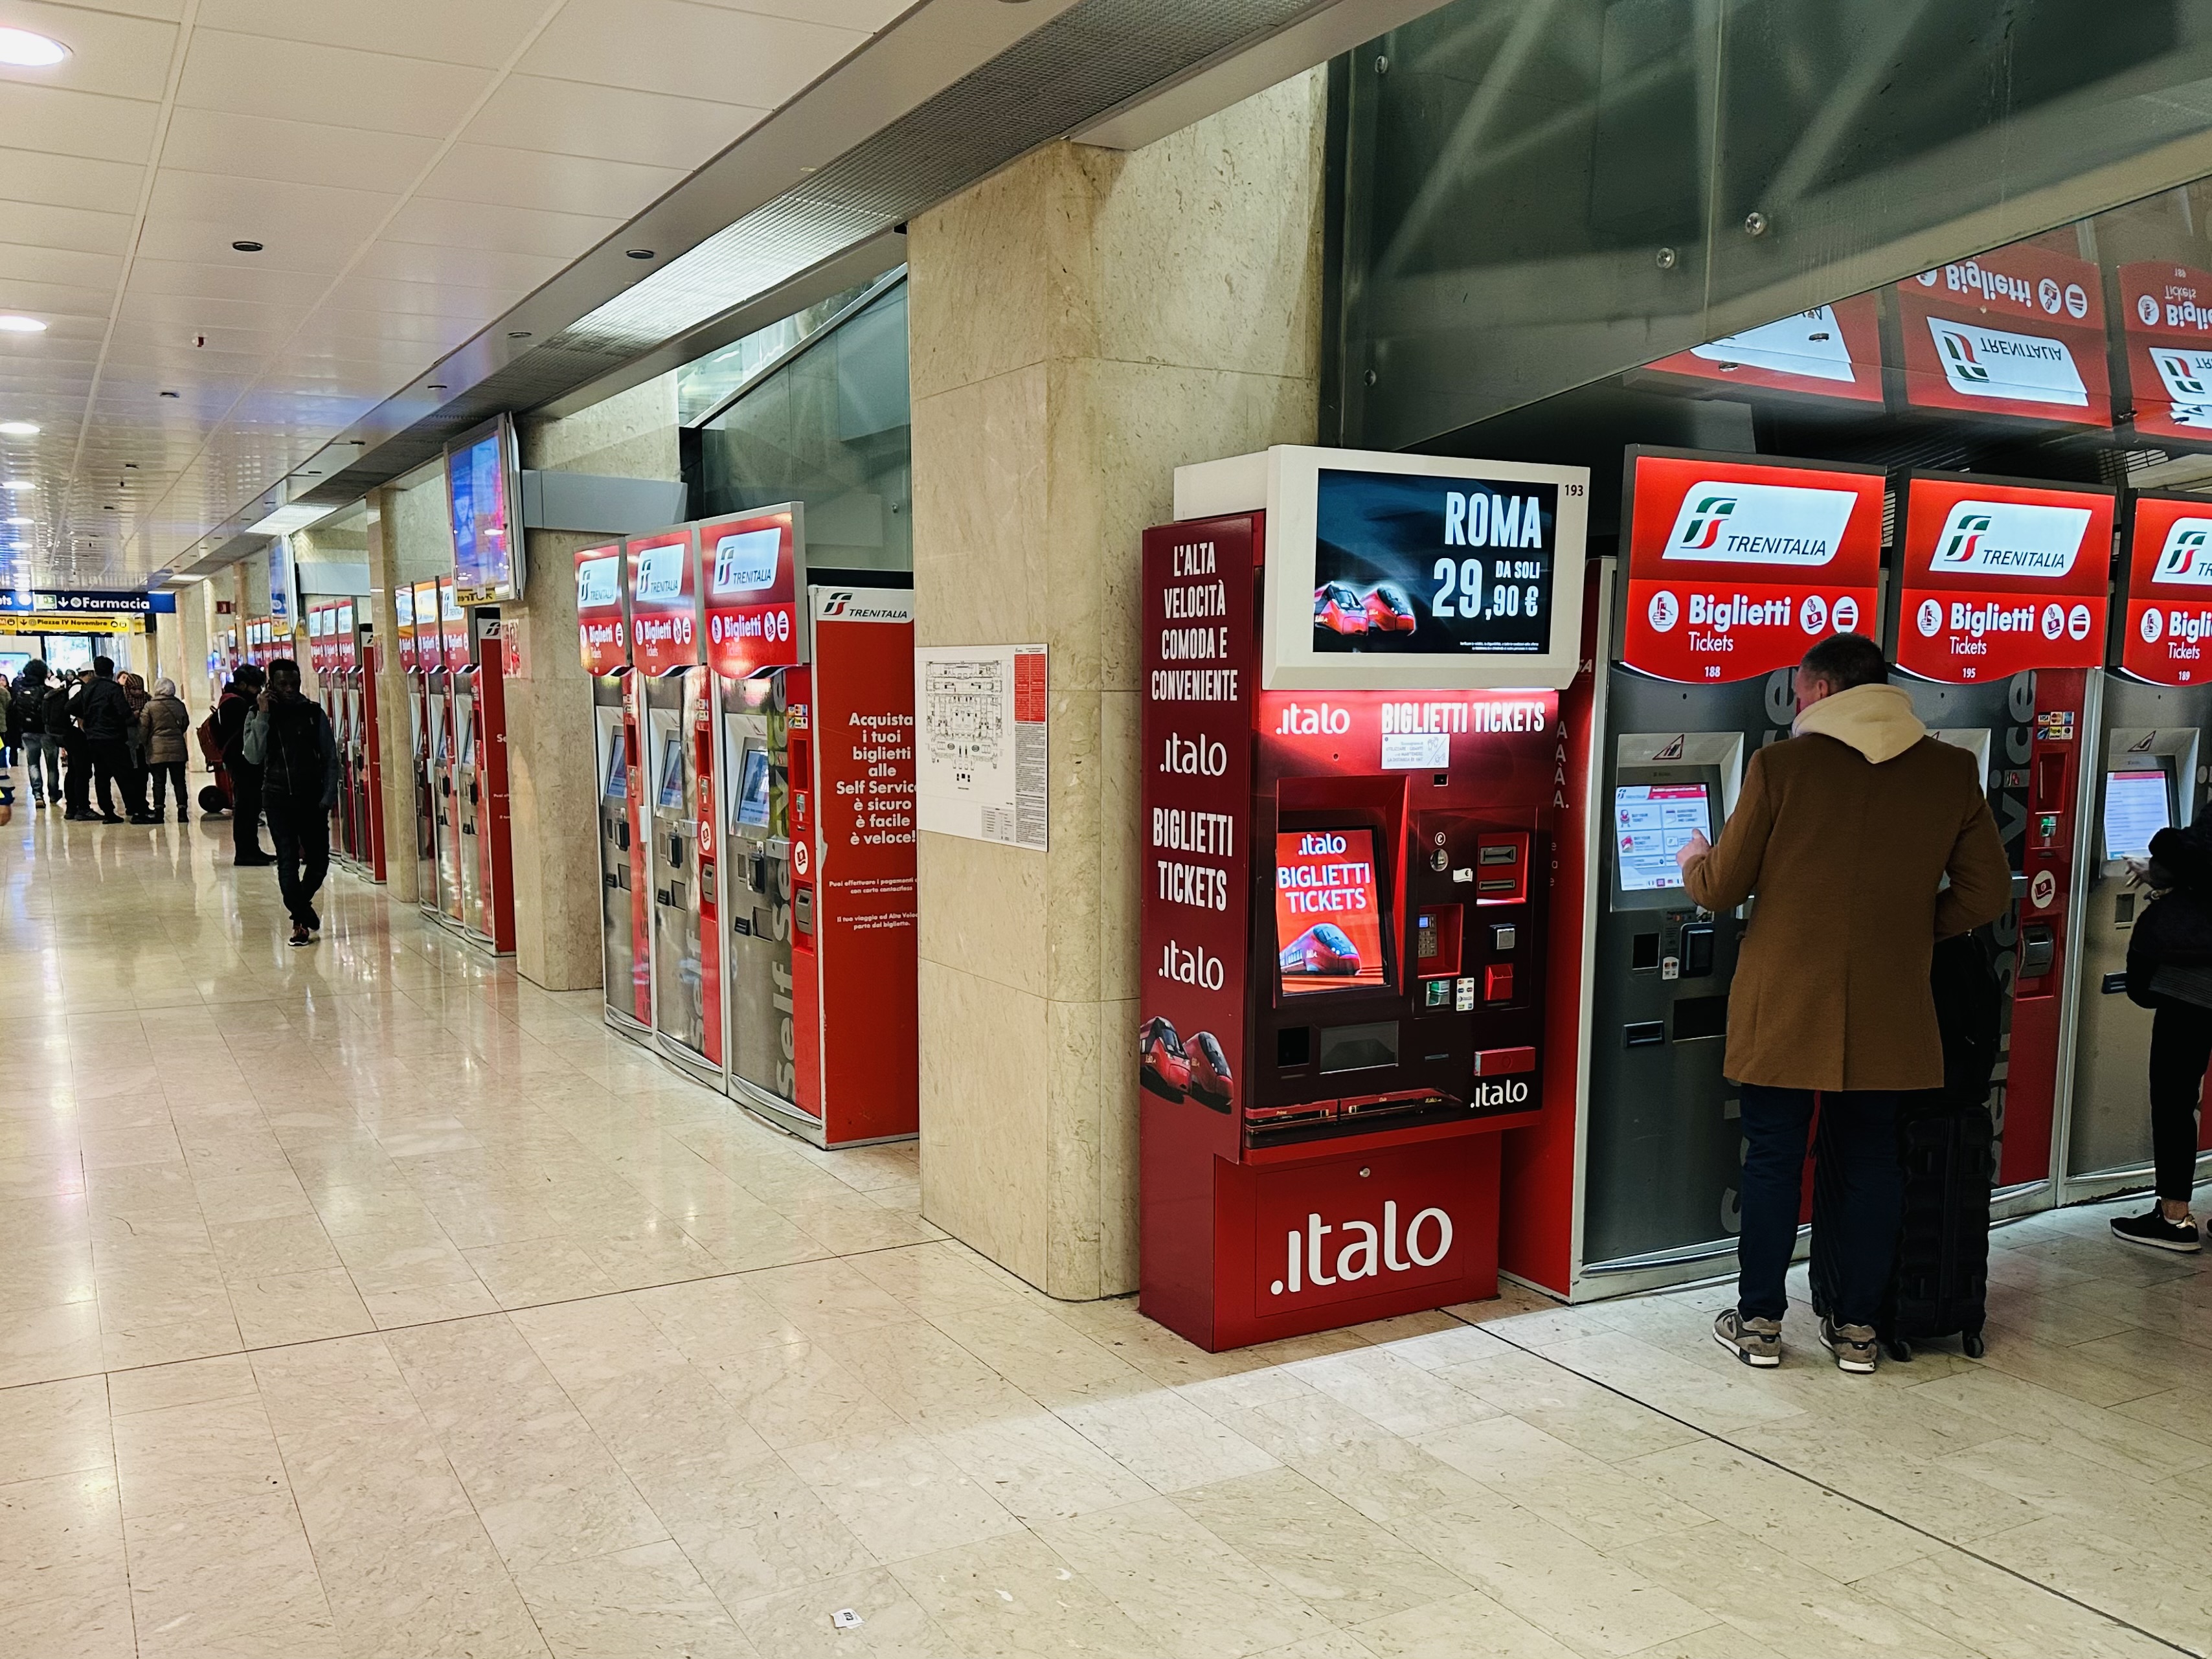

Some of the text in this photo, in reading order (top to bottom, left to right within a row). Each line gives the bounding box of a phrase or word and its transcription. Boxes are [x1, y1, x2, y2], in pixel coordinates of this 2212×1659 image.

[1564, 484, 1584, 497] 193
[1444, 491, 1542, 548] ROMA
[1727, 535, 1826, 557] TRENITALIA
[1173, 541, 1216, 577] L'ALTA
[1982, 549, 2065, 569] TRENITALIA
[733, 568, 771, 585] TRENITALIA
[1495, 561, 1540, 580] DA SOLI
[83, 597, 150, 610] Farmacia
[1164, 580, 1226, 618] VELOCITÀ
[849, 608, 908, 619] TRENITALIA
[1688, 594, 1792, 632] Biglietti
[1950, 602, 2035, 637] Biglietti
[644, 619, 672, 644] Biglietti
[723, 614, 762, 643] Biglietti
[1162, 627, 1228, 660] COMODA E
[1687, 631, 1733, 652] Tickets
[1949, 636, 1987, 655] Tickets
[2168, 642, 2200, 660] Tickets
[1704, 666, 1721, 678] 188
[1962, 667, 1976, 679] 195
[2178, 670, 2191, 681] 189
[1151, 670, 1238, 701] CONVENIENTE
[849, 712, 913, 728] Acquista
[1381, 701, 1546, 734] BIGLIETTI TICKETS
[863, 730, 902, 743] i tuoi
[852, 747, 912, 763] biglietti
[868, 763, 897, 778] alle
[836, 780, 865, 795] Self
[853, 797, 912, 811] è sicuro
[855, 813, 911, 828] è facile
[850, 830, 916, 845] è veloce!
[1152, 807, 1234, 858] BIGLIETTI
[1278, 862, 1371, 890] BIGLIETTI
[1157, 860, 1228, 912] TICKETS
[1285, 887, 1367, 914] TICKETS
[854, 914, 878, 923] viaggio
